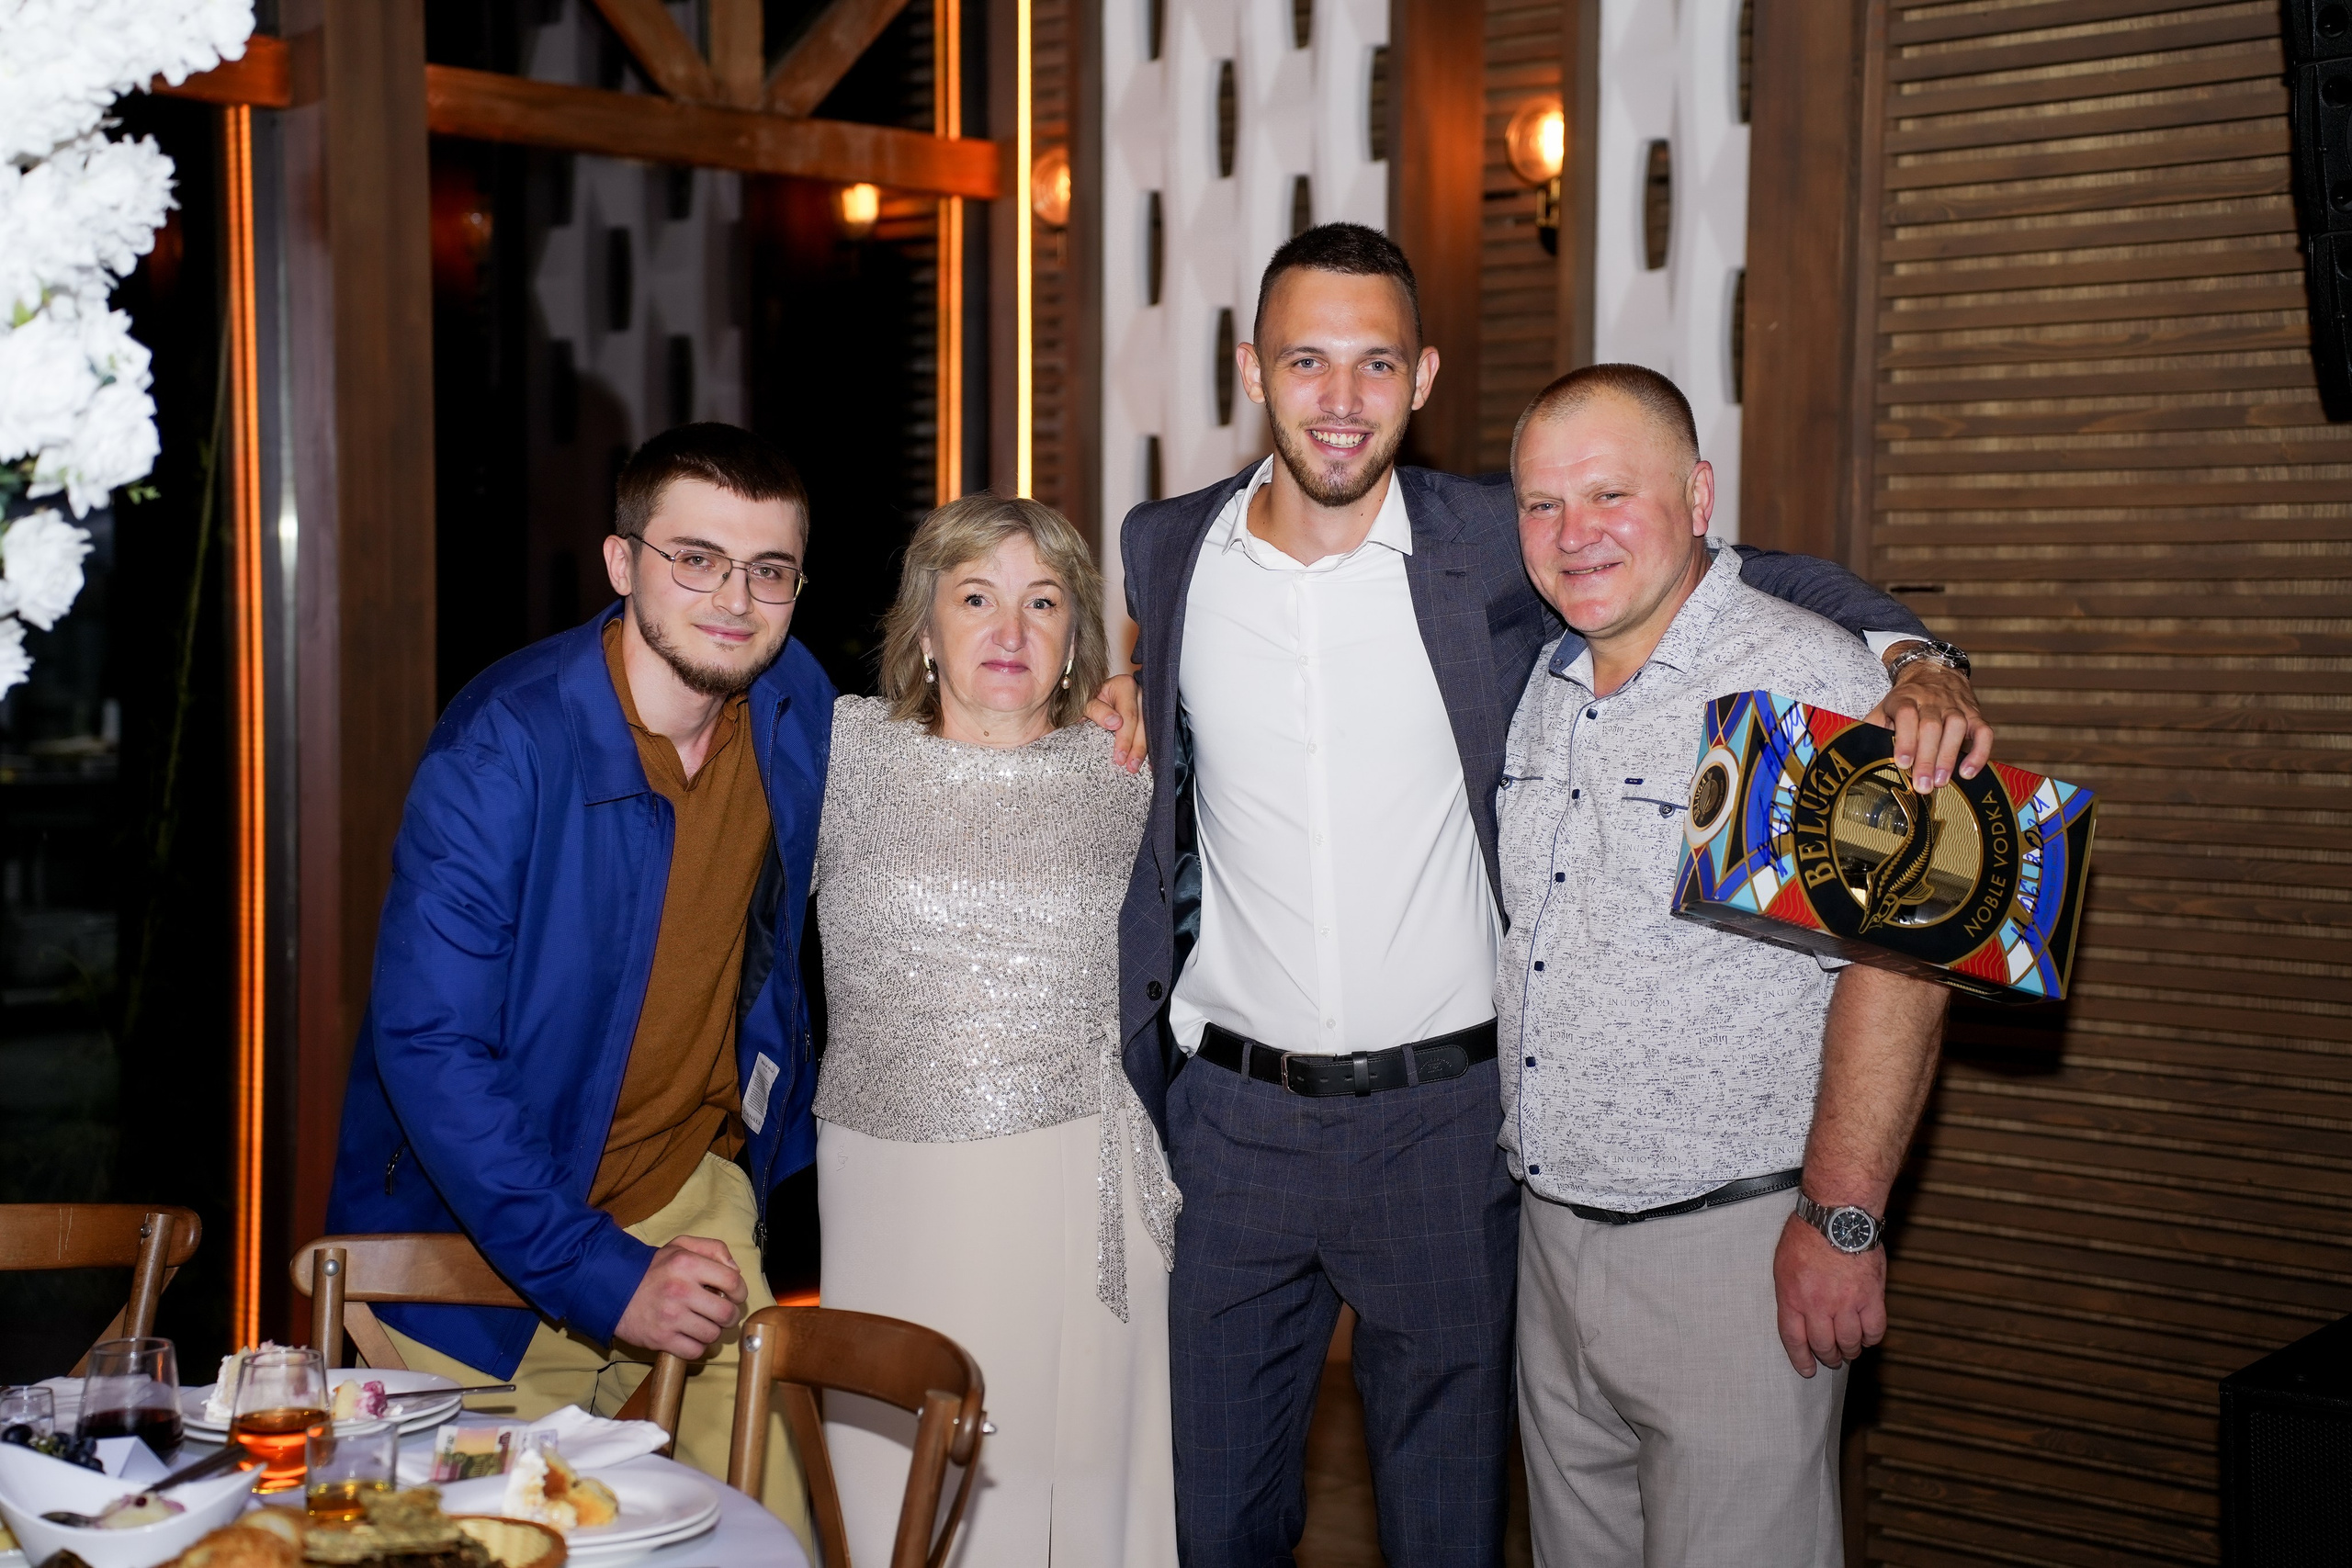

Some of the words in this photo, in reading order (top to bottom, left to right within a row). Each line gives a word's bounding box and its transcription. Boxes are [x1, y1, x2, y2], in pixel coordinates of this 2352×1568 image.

[1798, 747, 1856, 889] BELUGA
[1981, 790, 2009, 867] VODKA
[1963, 874, 2007, 938] NOBLE
